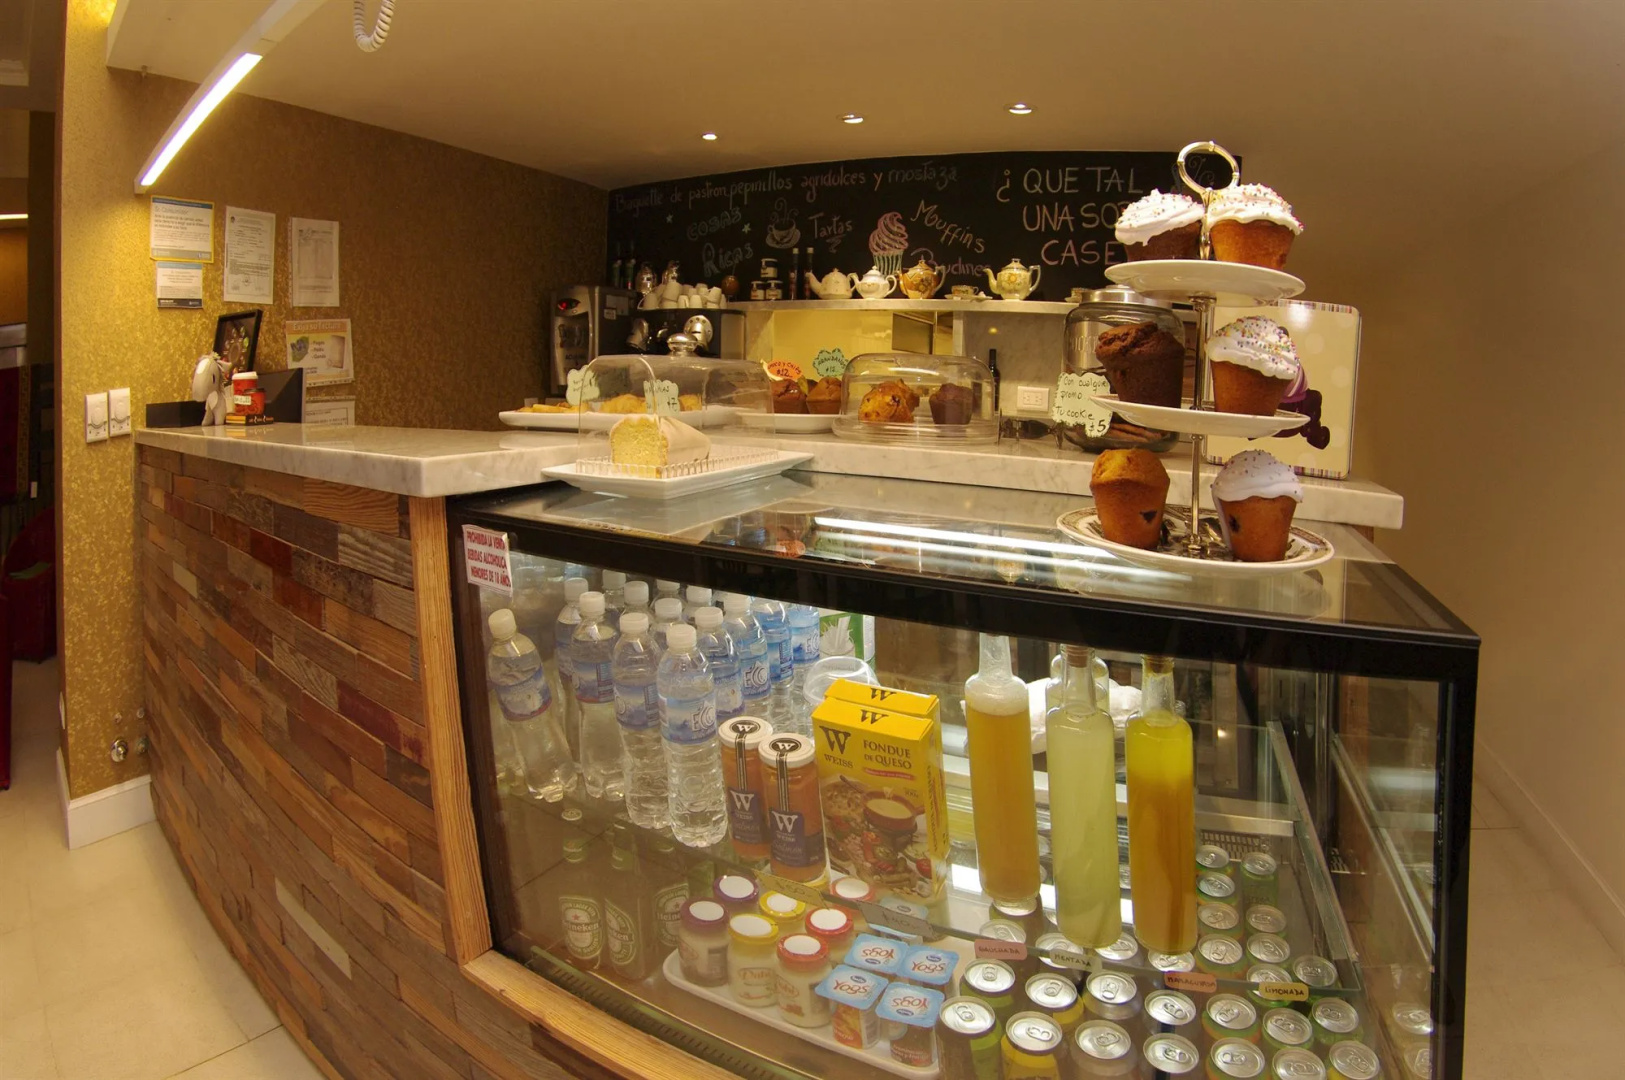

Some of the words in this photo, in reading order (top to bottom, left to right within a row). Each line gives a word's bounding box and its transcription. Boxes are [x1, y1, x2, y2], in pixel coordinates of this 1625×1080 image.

[670, 185, 682, 203] de
[730, 171, 793, 209] pepinillos
[801, 166, 866, 202] agridulces
[873, 172, 883, 191] y
[888, 160, 957, 190] mostaza
[1023, 168, 1079, 194] QUE
[1085, 166, 1143, 194] TAL
[808, 212, 853, 239] Tartas
[1023, 202, 1075, 232] UNA
[1081, 201, 1130, 229] SO
[1041, 239, 1122, 267] CASE
[471, 566, 488, 581] MENORES
[489, 570, 494, 582] DE
[869, 687, 898, 701] W
[860, 709, 889, 725] W
[736, 723, 754, 733] W
[775, 741, 796, 751] W
[819, 725, 851, 755] W
[863, 739, 911, 759] FONDUE
[824, 753, 853, 769] WEISS
[864, 754, 874, 762] DE
[875, 754, 912, 770] QUESO
[730, 790, 755, 812] W
[772, 810, 798, 834] W
